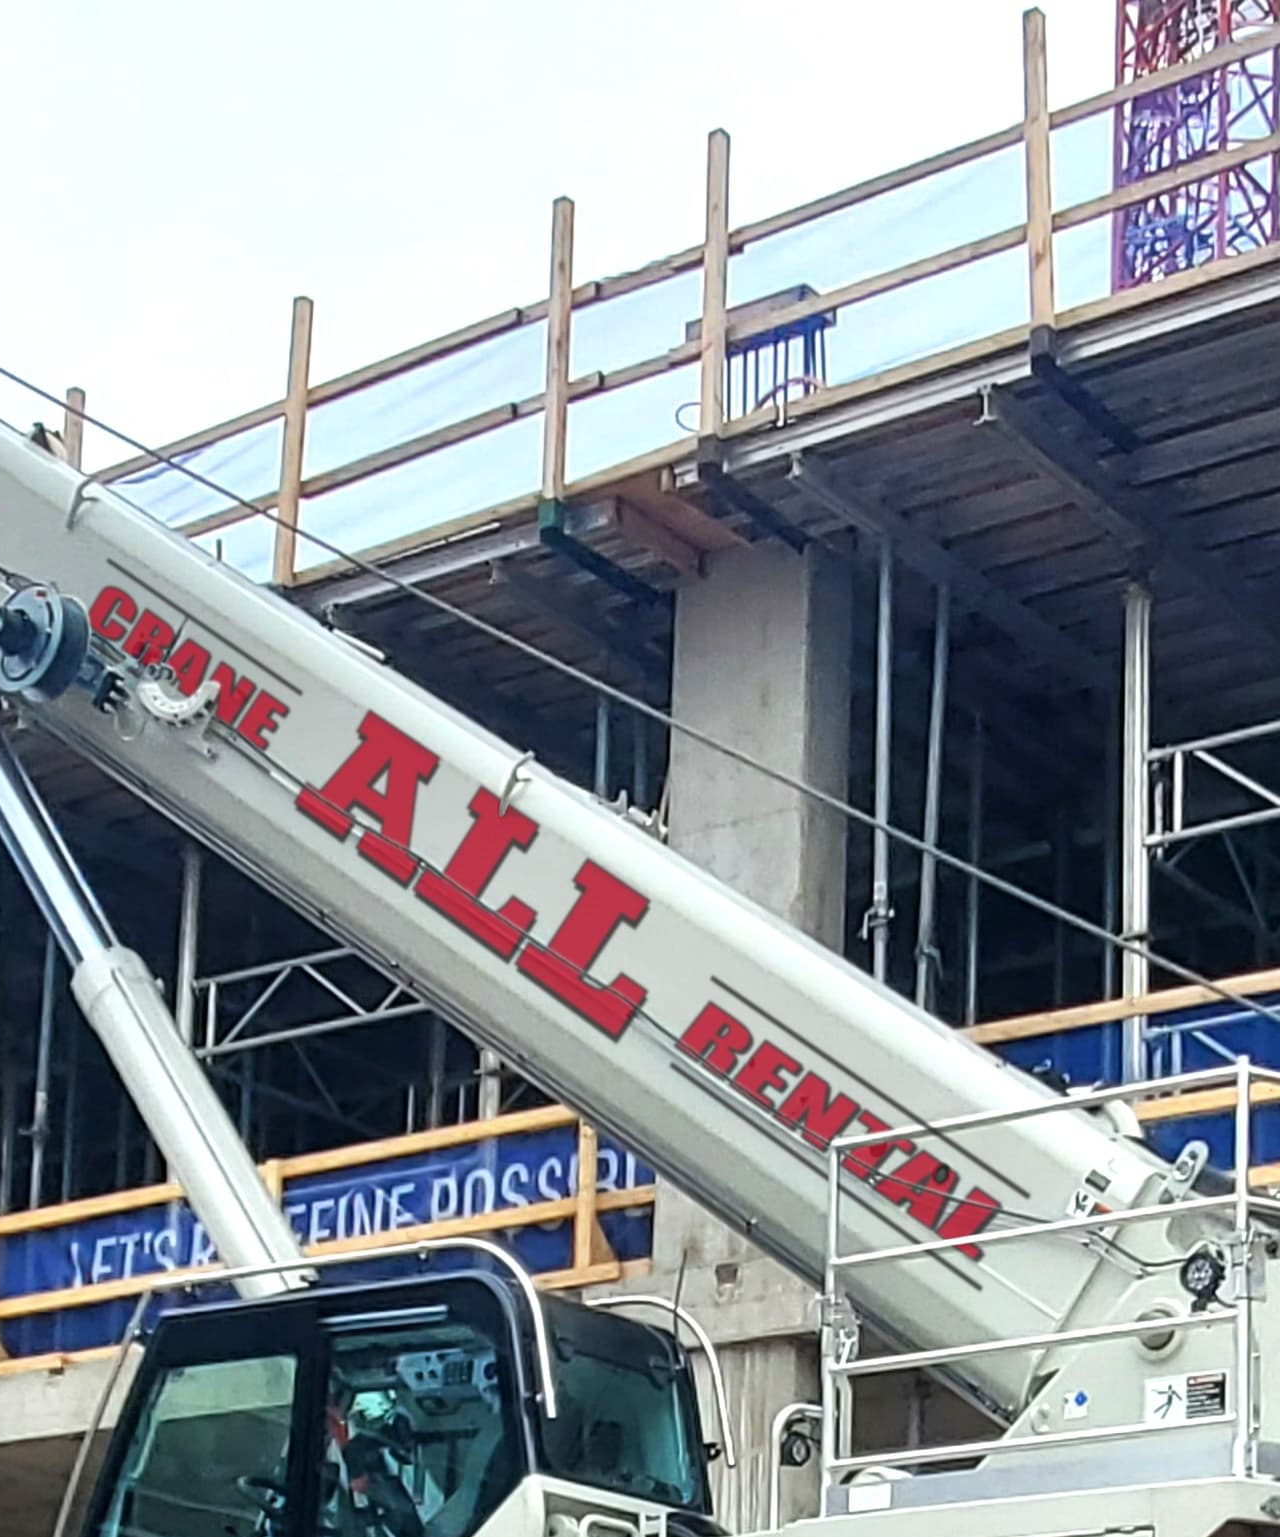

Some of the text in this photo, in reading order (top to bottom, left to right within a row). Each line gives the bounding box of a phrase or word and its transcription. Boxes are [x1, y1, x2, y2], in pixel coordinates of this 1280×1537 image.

[89, 585, 1004, 1263] CRANE ALL RENTAL
